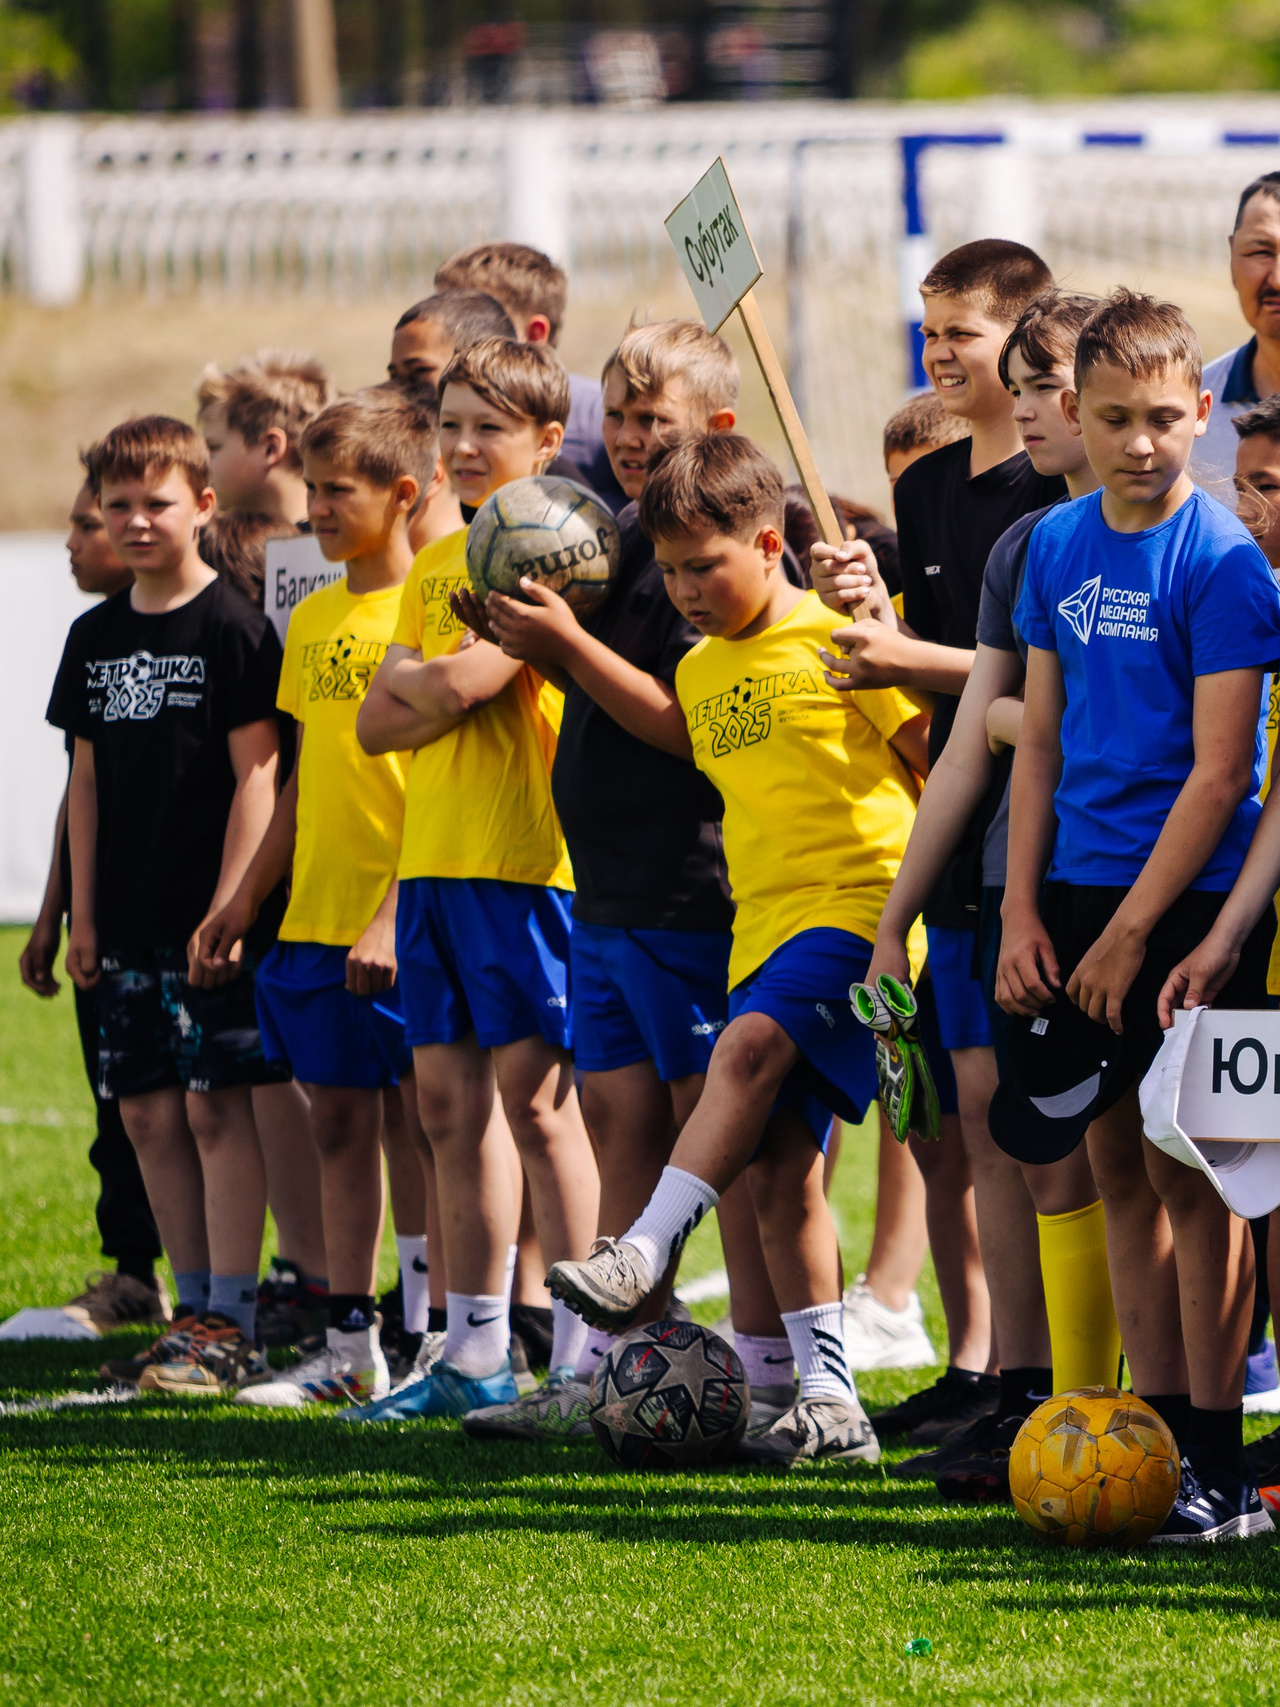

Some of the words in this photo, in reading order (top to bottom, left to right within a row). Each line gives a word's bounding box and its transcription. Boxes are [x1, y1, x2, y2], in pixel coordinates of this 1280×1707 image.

[684, 203, 739, 288] Субутак
[1102, 587, 1150, 607] РУССКАЯ
[1099, 604, 1147, 623] МЕДНАЯ
[1096, 621, 1159, 642] КОМПАНИЯ
[104, 683, 166, 721] 2025
[709, 702, 771, 758] 2025
